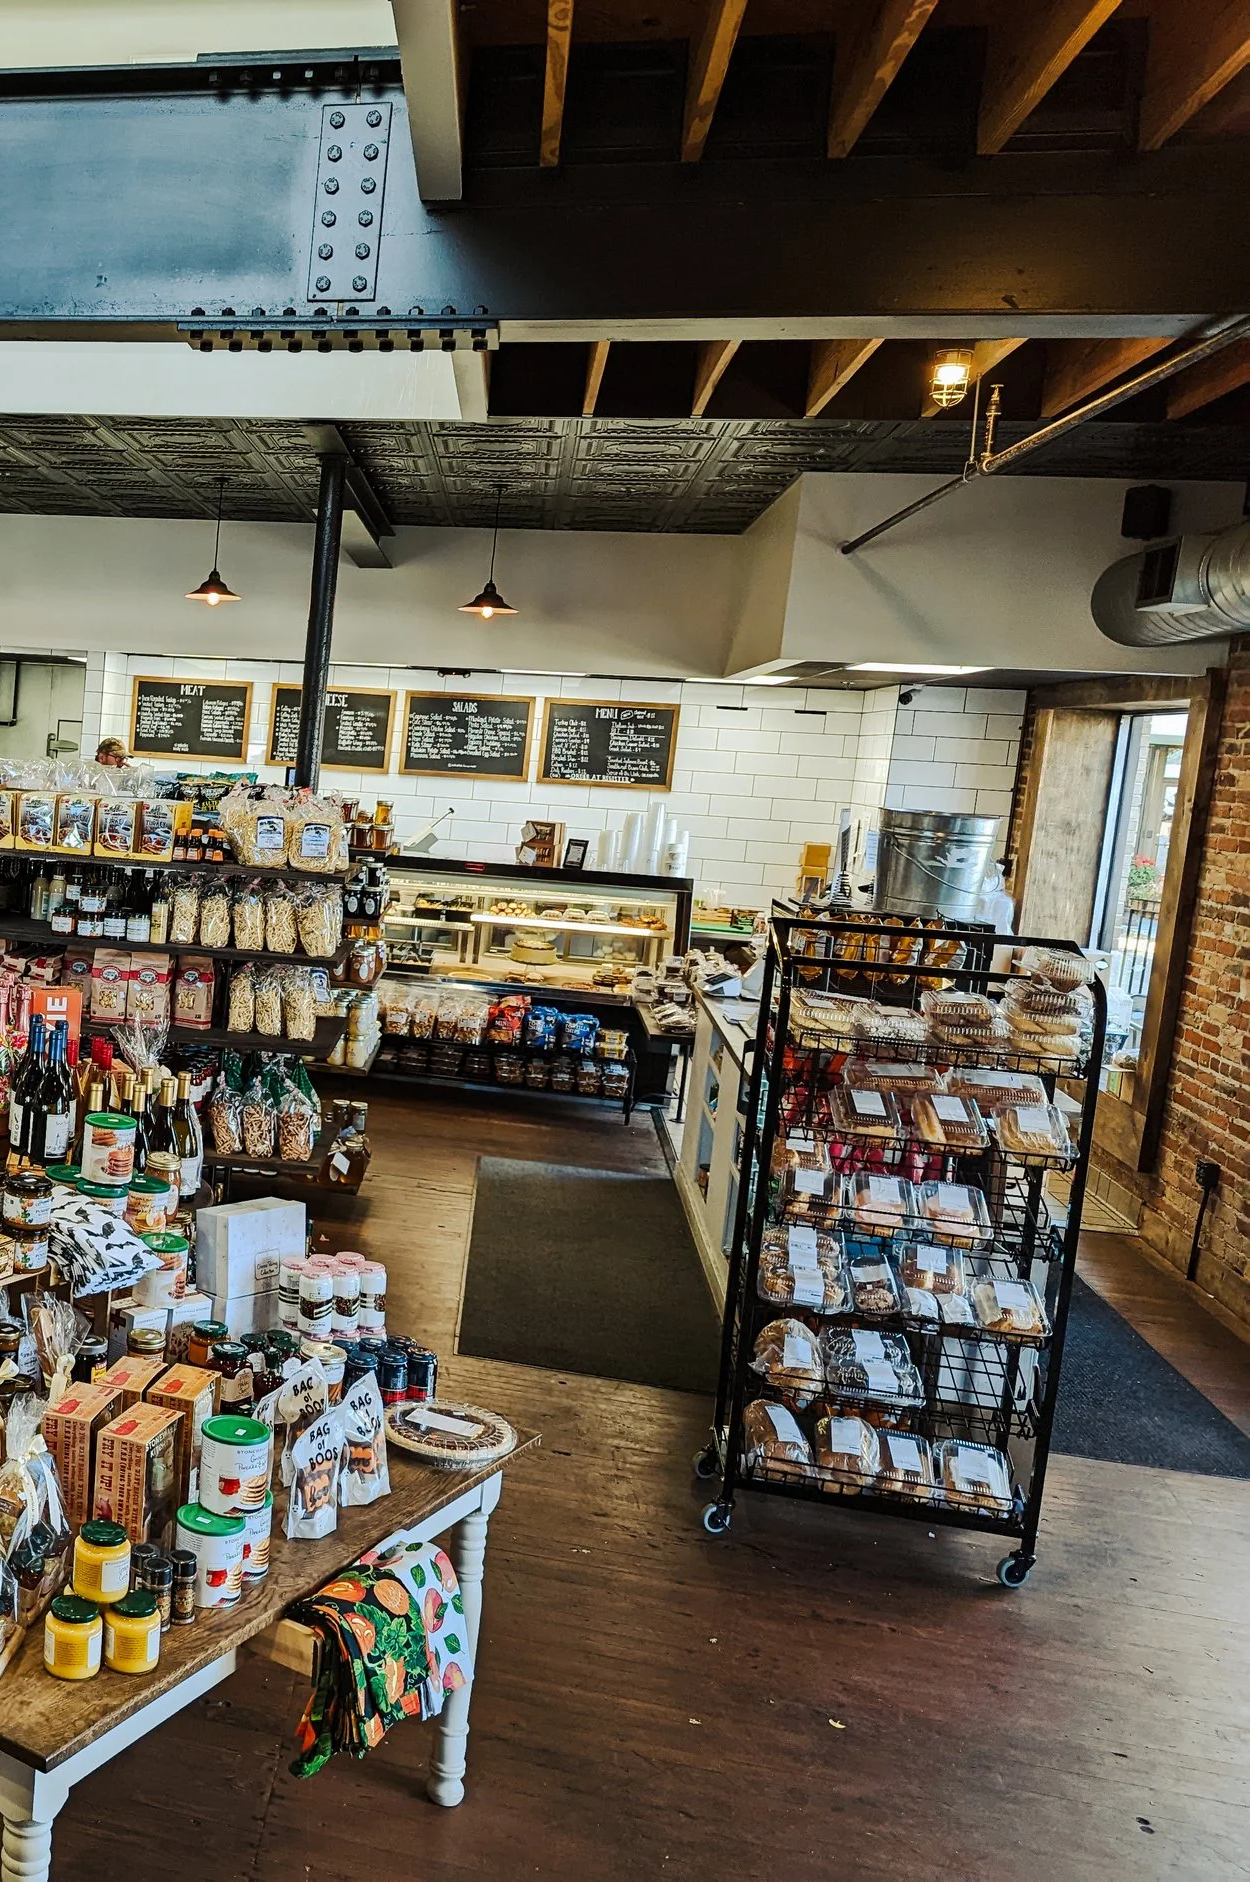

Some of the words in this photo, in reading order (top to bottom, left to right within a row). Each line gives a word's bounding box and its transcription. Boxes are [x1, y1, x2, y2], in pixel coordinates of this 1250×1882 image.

[180, 685, 206, 696] MEAT
[326, 694, 348, 707] EESE
[452, 702, 478, 713] SALADS
[596, 708, 618, 719] MENU
[292, 1377, 314, 1396] BAG
[304, 1393, 312, 1402] of
[350, 1393, 372, 1412] BAG
[46, 1417, 58, 1438] FRY
[310, 1422, 330, 1443] BAG
[102, 1437, 114, 1458] FRY
[137, 1445, 142, 1454] DO
[318, 1440, 326, 1450] of
[309, 1447, 338, 1471] BOOS
[101, 1461, 114, 1472] IT
[100, 1475, 112, 1492] UP!
